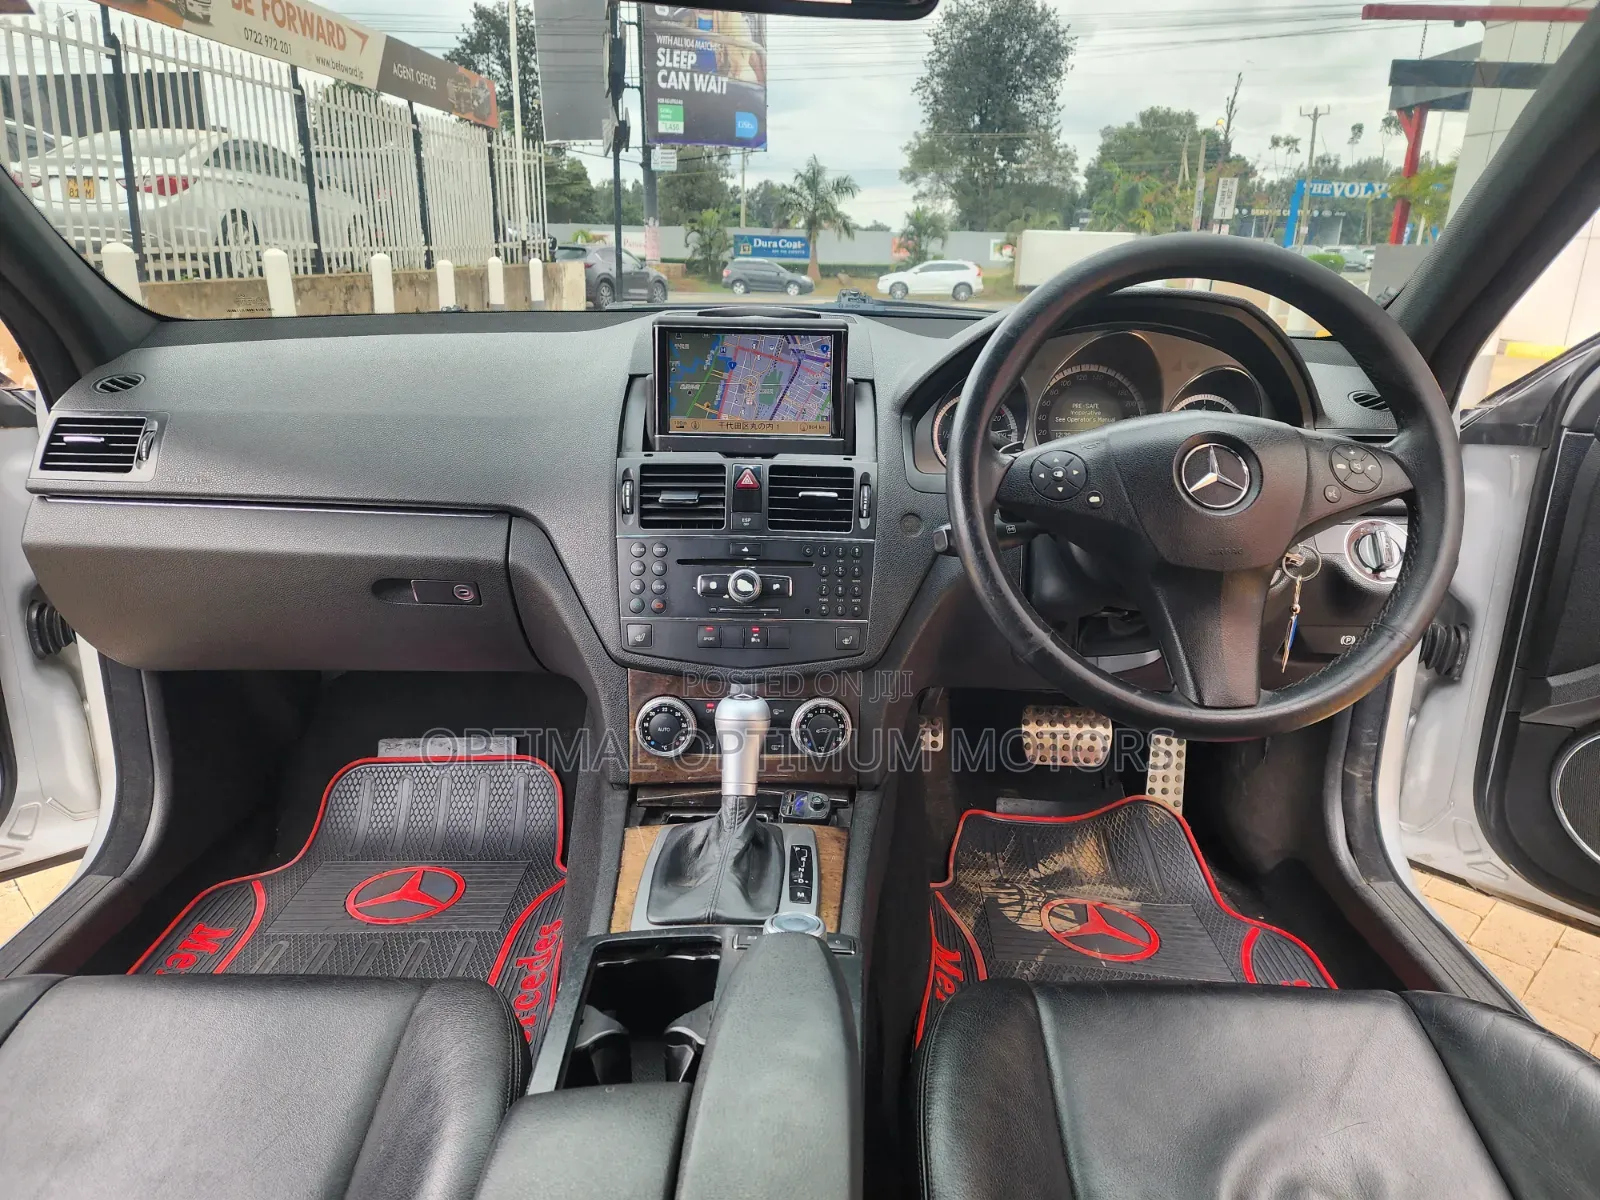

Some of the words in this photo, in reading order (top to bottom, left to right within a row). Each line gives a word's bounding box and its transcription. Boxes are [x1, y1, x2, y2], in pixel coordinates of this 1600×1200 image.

[260, 0, 347, 51] FORWARD
[244, 27, 264, 45] 0722
[264, 35, 279, 50] 972
[280, 41, 292, 56] 201
[655, 33, 674, 46] WITH
[673, 36, 684, 48] ALL
[684, 38, 695, 49] 104
[656, 47, 697, 70] SLEEP
[392, 62, 414, 83] AGENT
[416, 70, 437, 90] OFFICE
[657, 69, 690, 91] CAN
[694, 73, 728, 95] WAIT
